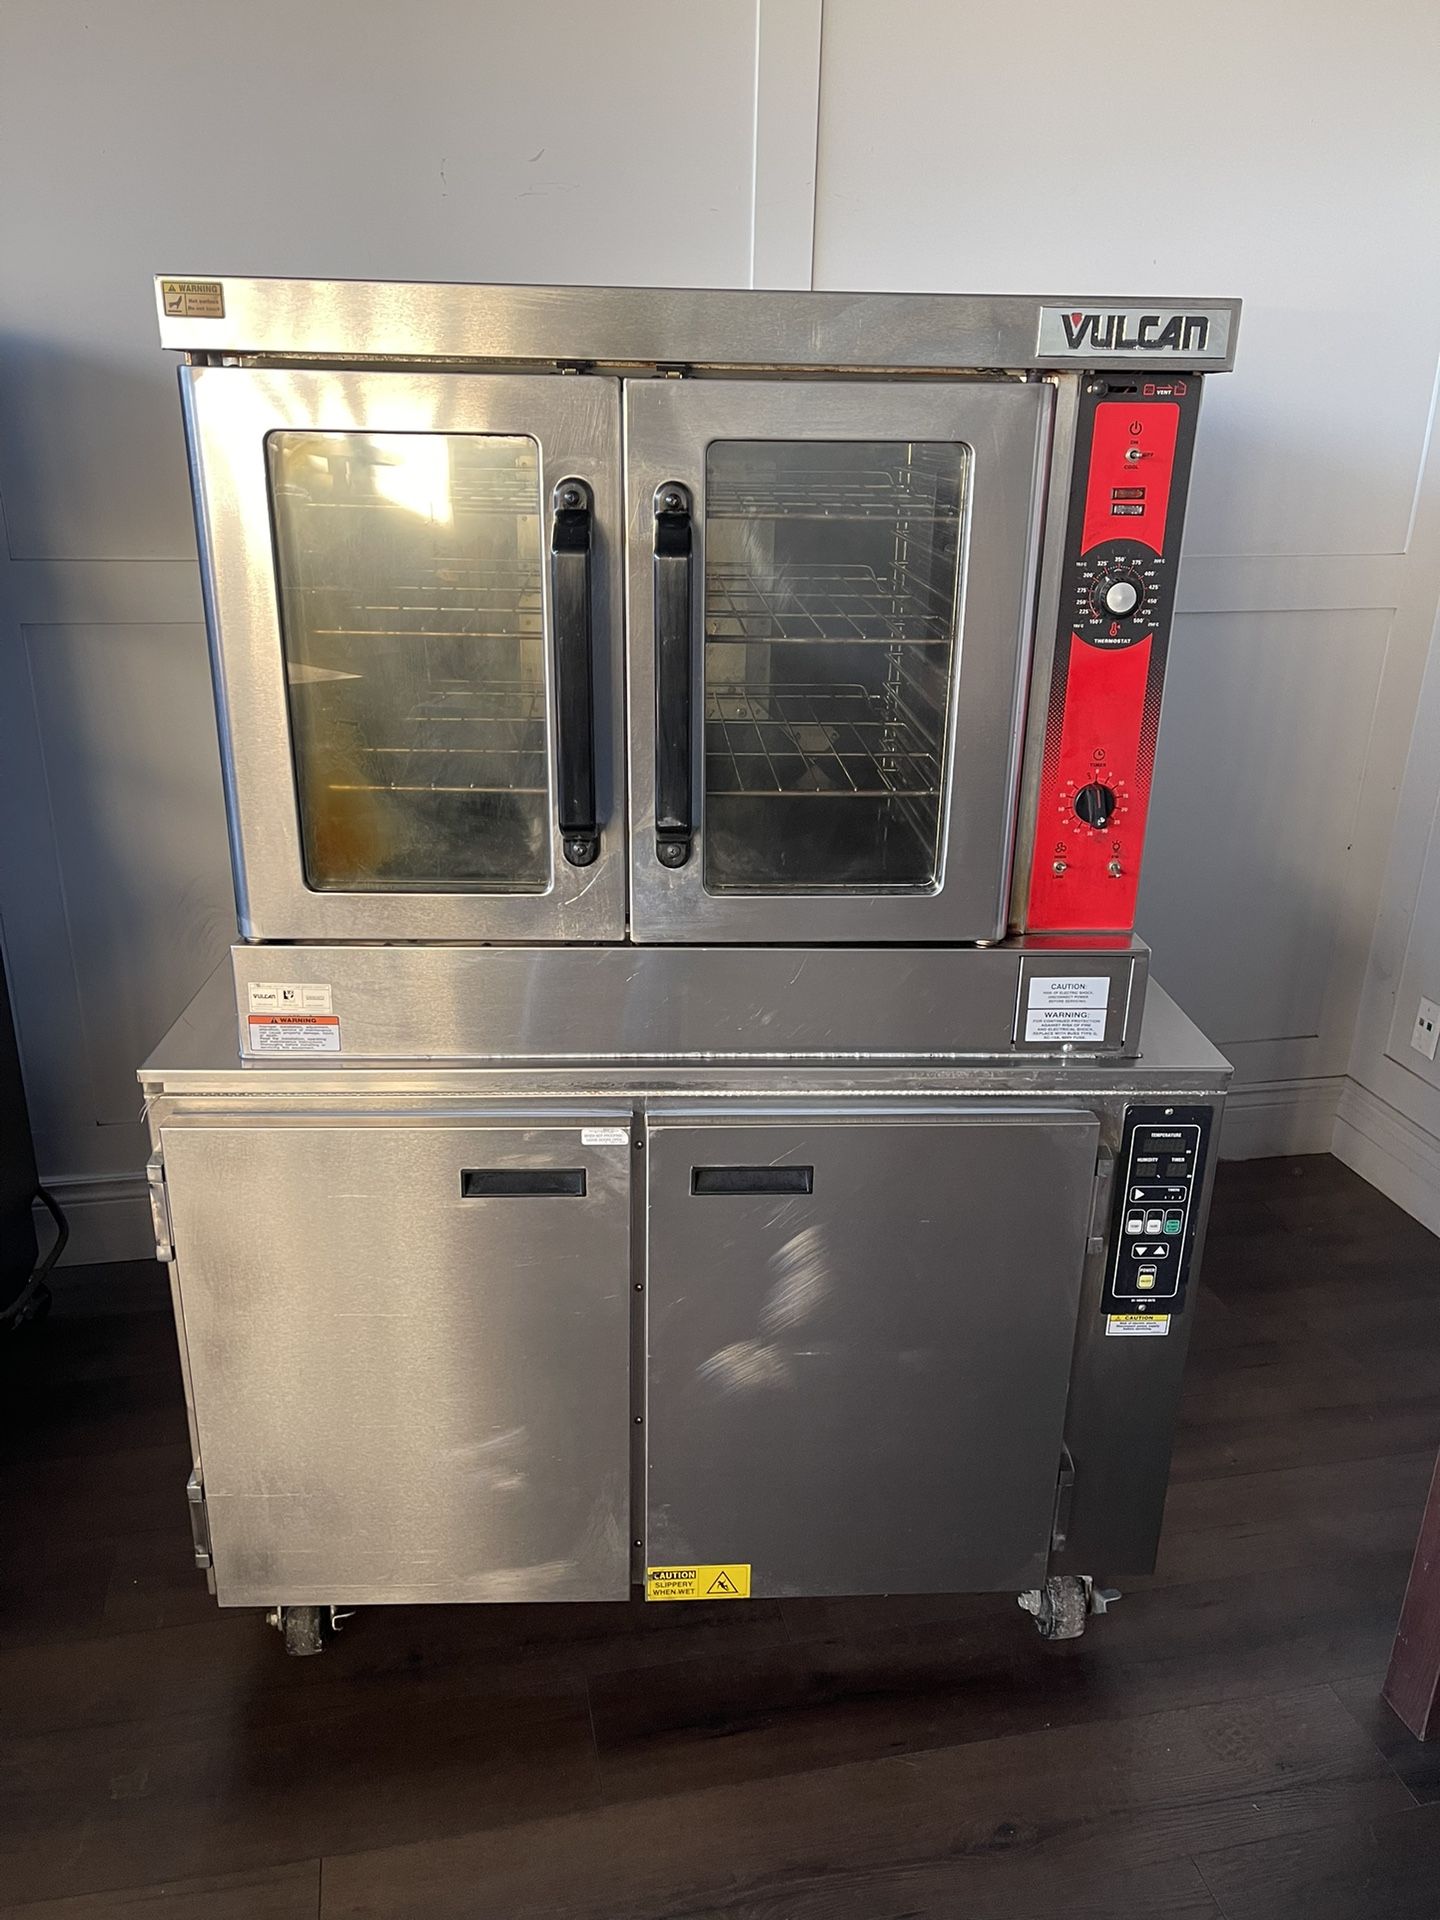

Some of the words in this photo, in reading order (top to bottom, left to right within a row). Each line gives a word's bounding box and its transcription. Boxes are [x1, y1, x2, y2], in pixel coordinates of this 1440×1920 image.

[179, 284, 218, 292] WARNING
[1062, 314, 1208, 350] VULCAN
[654, 1572, 695, 1580] CAUTION
